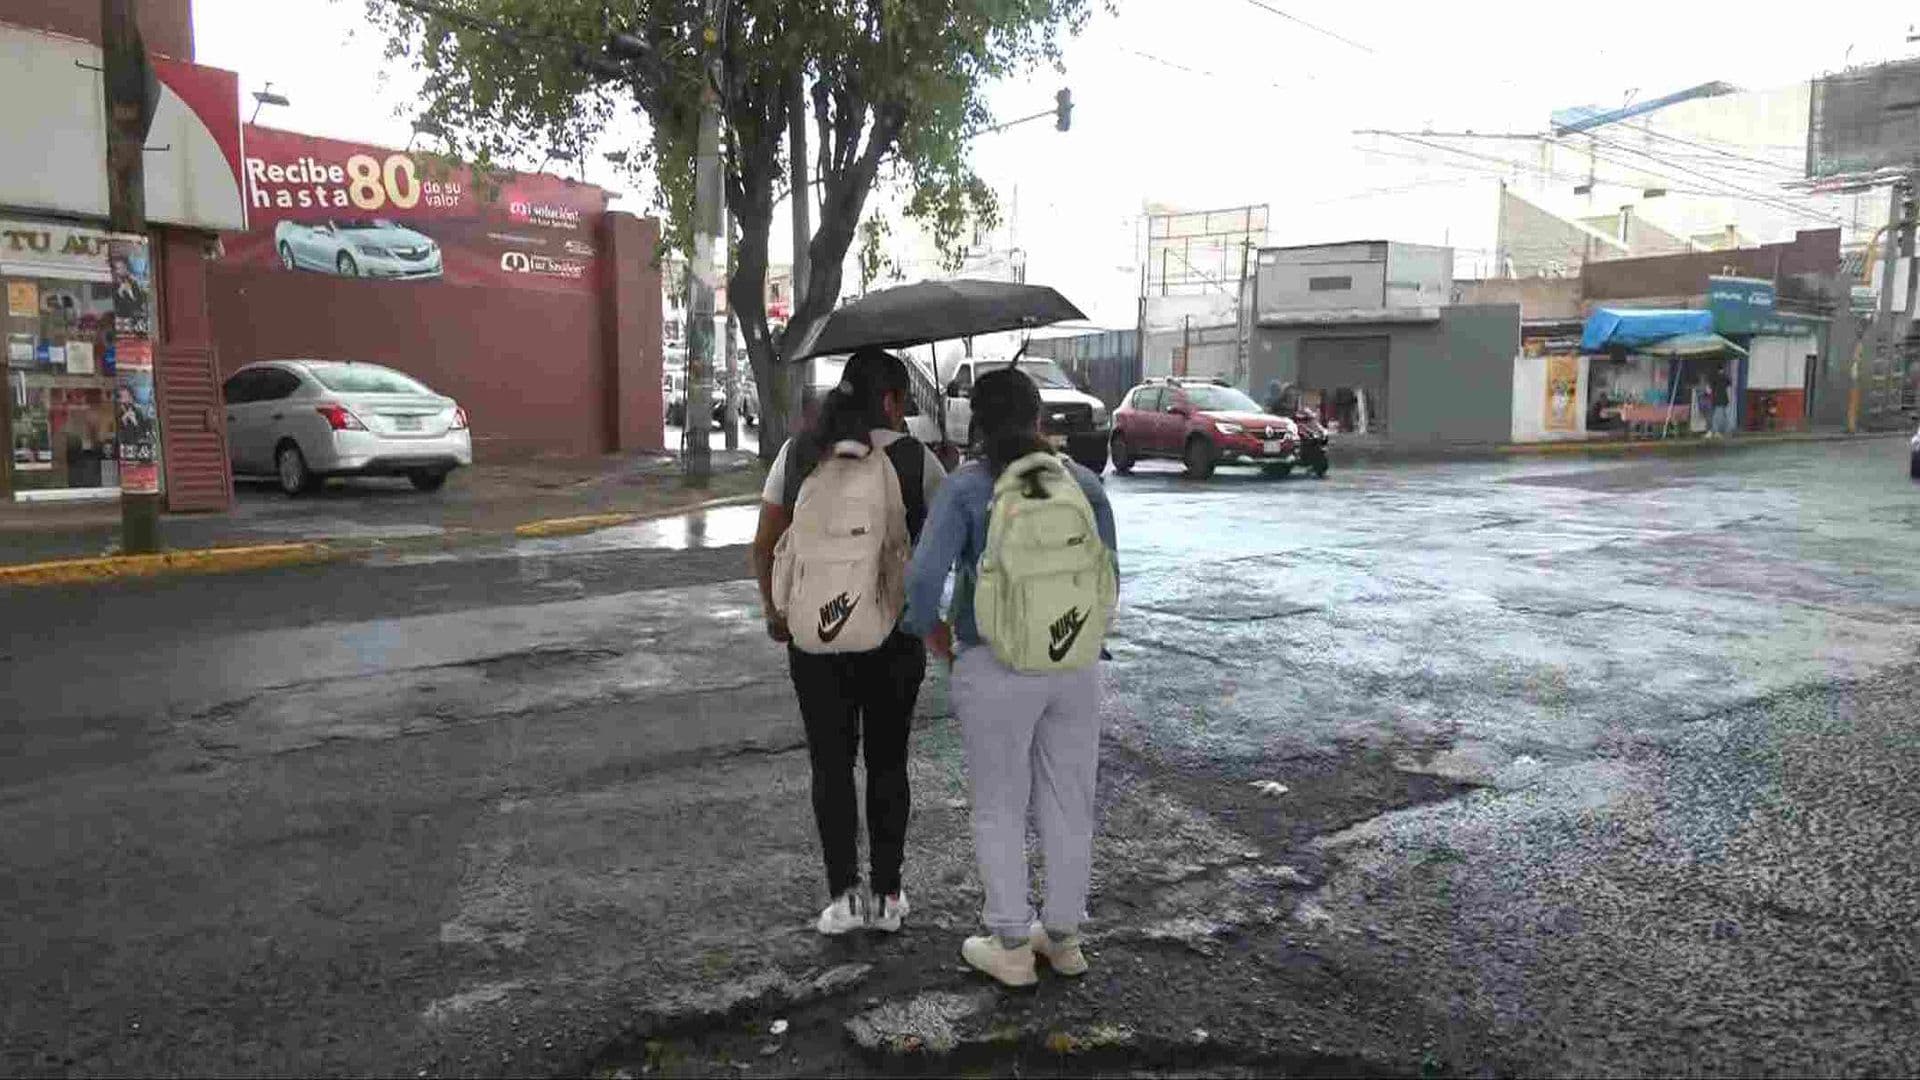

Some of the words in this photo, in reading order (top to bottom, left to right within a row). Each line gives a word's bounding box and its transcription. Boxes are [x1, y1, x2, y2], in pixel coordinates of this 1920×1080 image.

[246, 157, 345, 183] Recibe
[347, 154, 421, 210] 80
[251, 179, 349, 208] hasta
[425, 193, 460, 207] valor
[61, 233, 107, 256] AU
[818, 591, 851, 627] NIKE
[1049, 605, 1081, 643] NIKE
